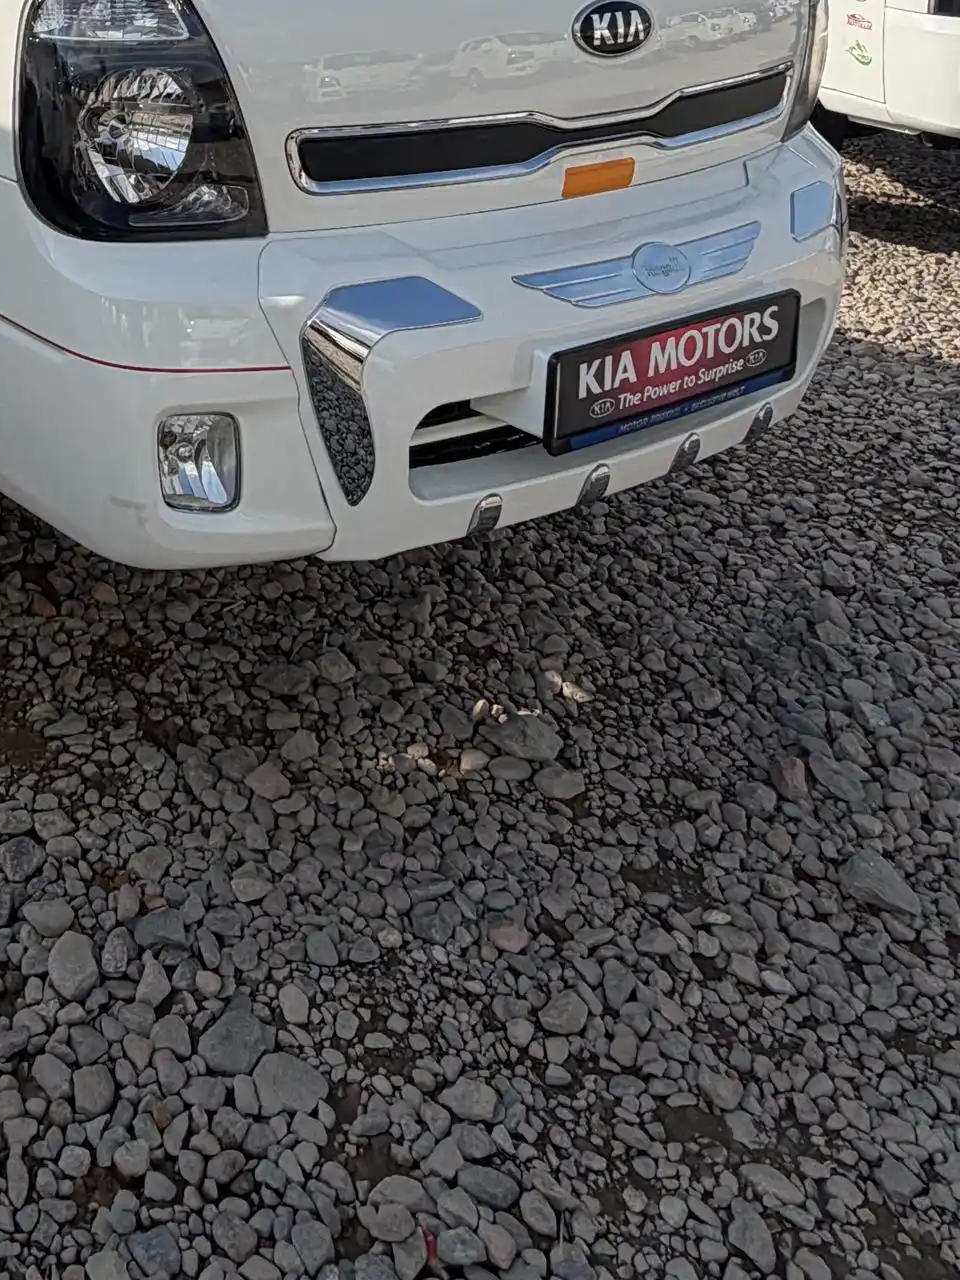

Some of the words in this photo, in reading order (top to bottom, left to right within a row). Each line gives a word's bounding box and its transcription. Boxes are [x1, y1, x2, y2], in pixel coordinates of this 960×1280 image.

[591, 9, 646, 47] KIA
[578, 349, 638, 400] KIA
[648, 305, 780, 377] MOTORS
[746, 350, 766, 366] KIA
[618, 392, 642, 410] The
[643, 379, 682, 403] Power
[682, 374, 697, 390] to
[697, 357, 745, 386] Surprise
[592, 400, 614, 417] KIA
